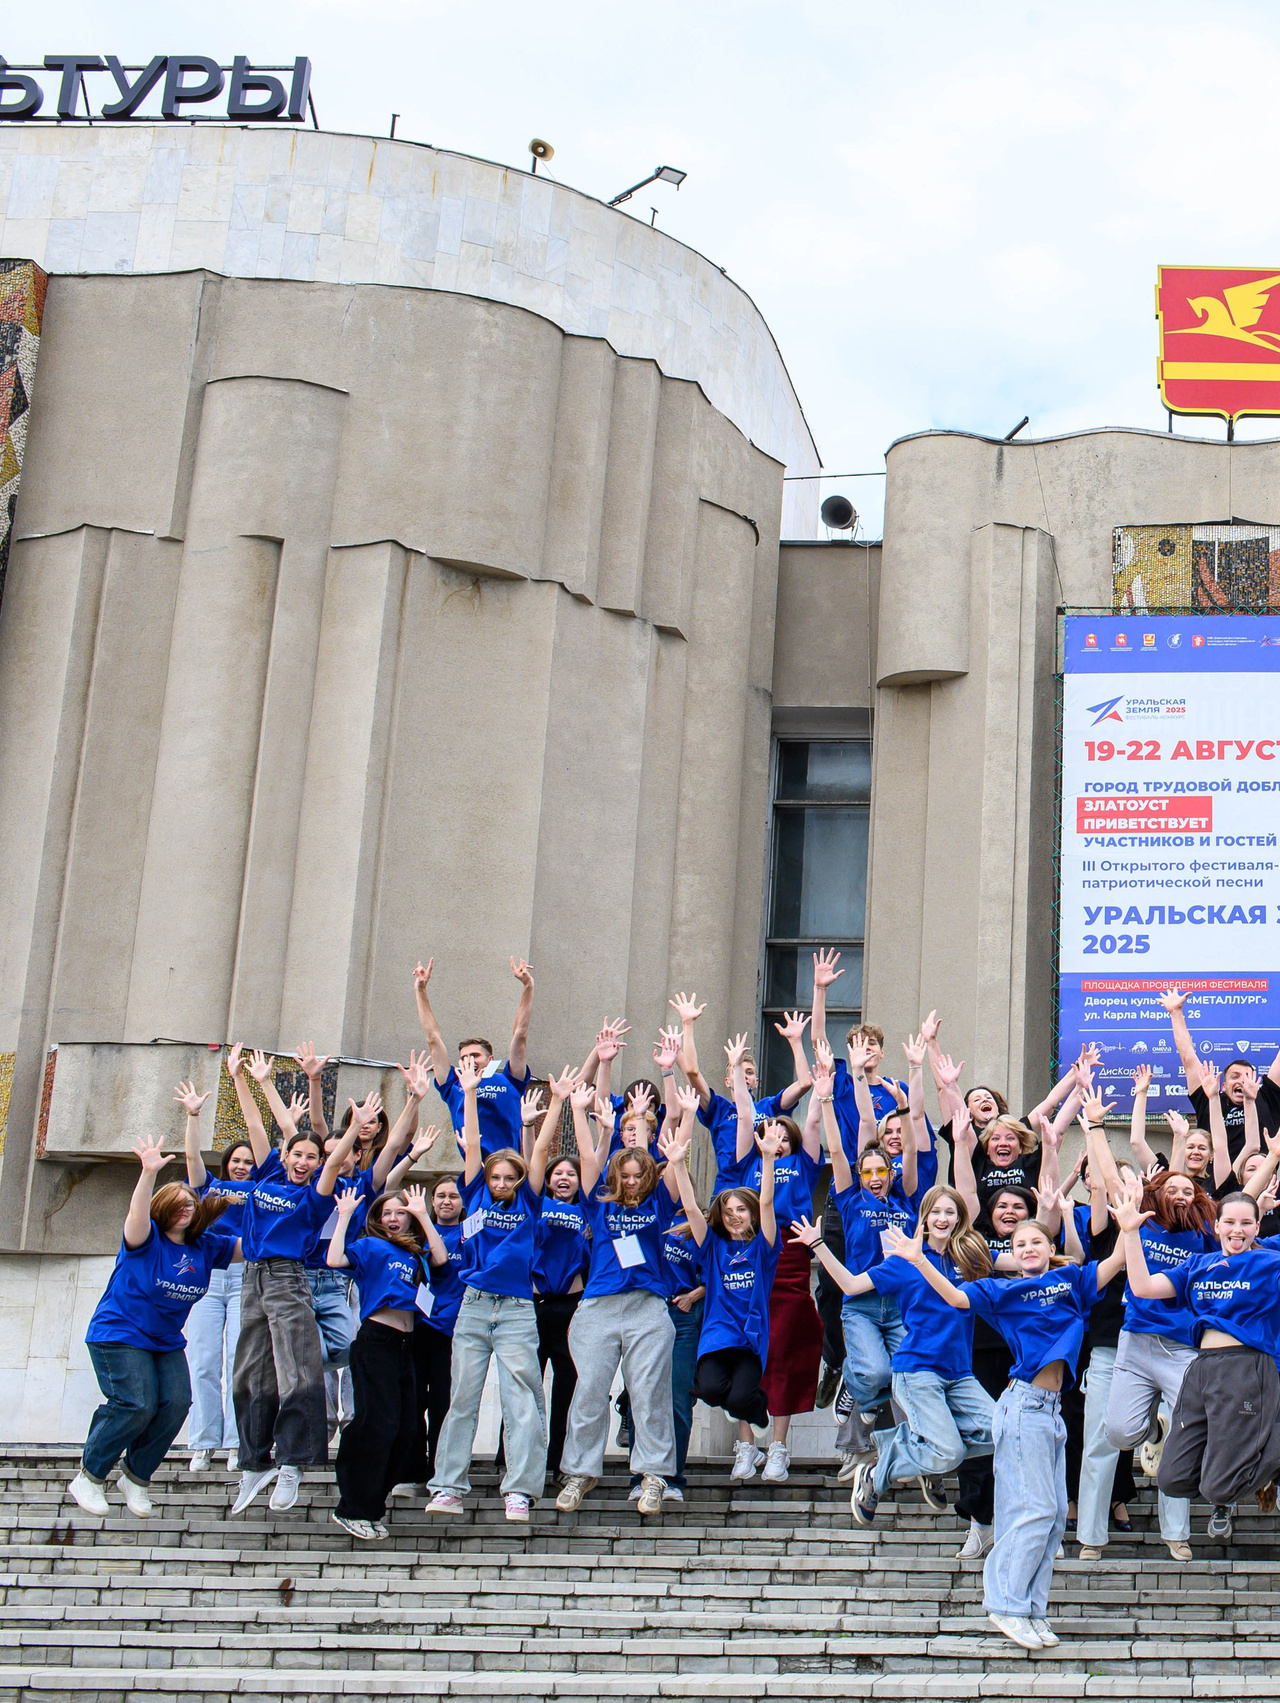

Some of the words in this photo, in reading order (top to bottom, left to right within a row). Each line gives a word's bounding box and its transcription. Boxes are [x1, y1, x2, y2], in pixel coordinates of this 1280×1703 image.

[1125, 698, 1186, 706] УРАЛЬСКАЯ
[1085, 740, 1162, 761] 19-22
[1084, 781, 1139, 794] ГОРОД
[1143, 778, 1232, 794] ТРУДОВОЙ
[1084, 799, 1169, 812] ЗЛАТОУСТ
[1084, 817, 1209, 830] ПРИВЕТСТВУЕТ
[1084, 836, 1194, 848] УЧАСТНИКОВ
[1199, 836, 1210, 847] И
[1215, 833, 1277, 847] ГОСТЕЙ
[1082, 860, 1096, 872] III
[1100, 860, 1185, 873] Открытого
[1082, 875, 1211, 889] патриотической
[1215, 877, 1264, 888] песни
[1084, 905, 1267, 926] УРАЛЬСКАЯ
[1083, 934, 1150, 954] 2025
[1084, 981, 1140, 990] ПЛОЩАДКА
[1142, 981, 1207, 990] ПРОВЕДЕНИЯ
[1209, 980, 1267, 989] ФЕСТИВАЛЯ
[1084, 996, 1128, 1006] Дворец
[1187, 995, 1267, 1006] «МЕТАЛЛУРГ»
[1084, 1012, 1100, 1021] ул.
[1103, 1010, 1137, 1020] Карла
[1188, 1010, 1201, 1019] 26
[987, 1176, 1022, 1187] ЗЕМЛЯ
[253, 1189, 297, 1211] РАЛЬСКАЯ
[552, 1218, 581, 1230] ЗЕМЛЯ
[1193, 1280, 1251, 1291] РАЛЬСКАЯ
[164, 1290, 197, 1302] ЗЕМЛЯ
[1196, 1290, 1233, 1300] ЗЕМЛЯ
